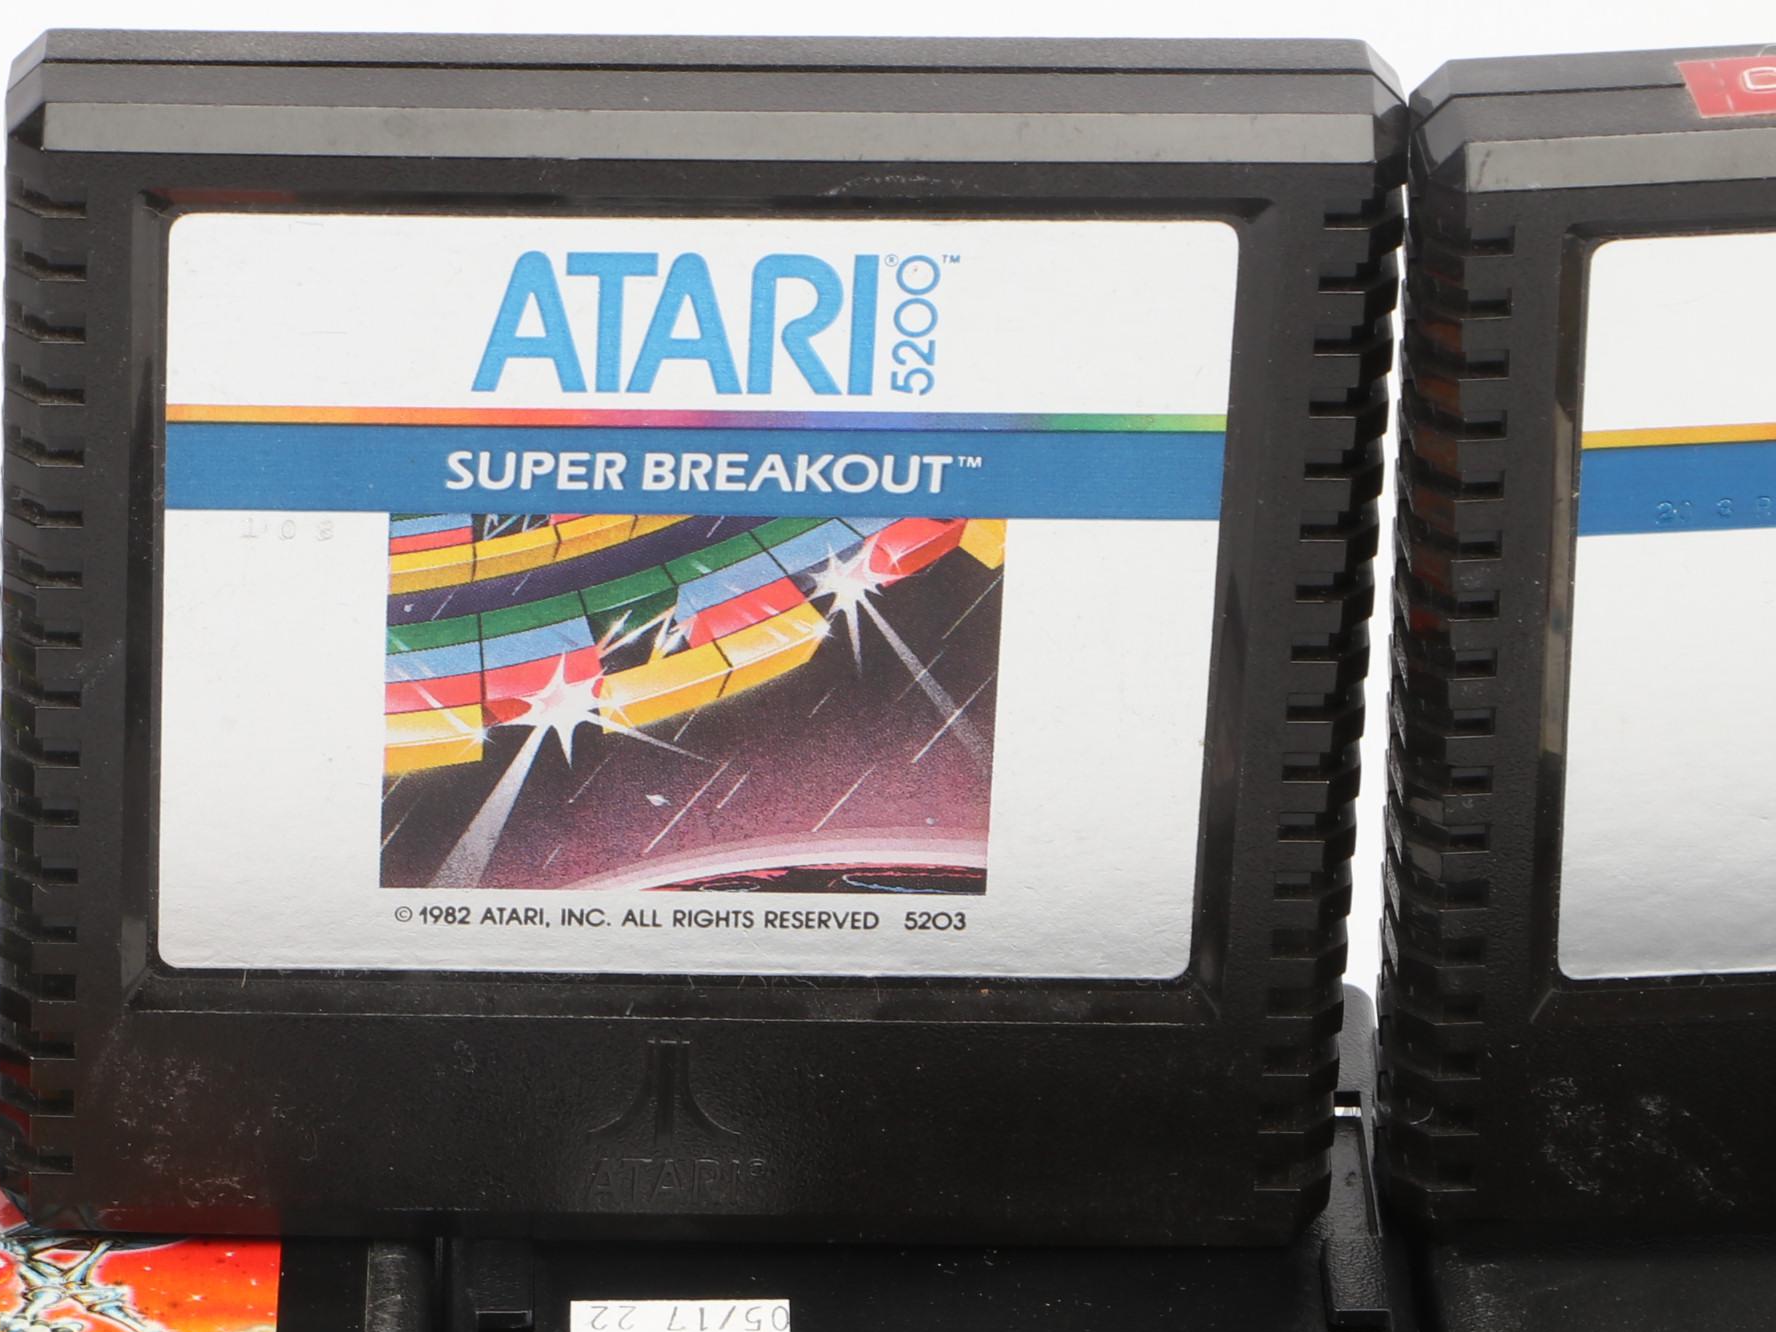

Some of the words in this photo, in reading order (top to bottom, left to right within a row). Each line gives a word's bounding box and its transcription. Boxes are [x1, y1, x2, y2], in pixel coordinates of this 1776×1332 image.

[446, 451, 628, 491] SUPER
[419, 906, 472, 926] 1982
[480, 907, 551, 929] ATARI,
[561, 908, 612, 927] INC.
[622, 909, 662, 928] ALL
[673, 909, 754, 929] RIGHTS
[764, 910, 880, 931] RESERVED
[904, 911, 967, 931] 5203
[589, 1305, 637, 1331] 22
